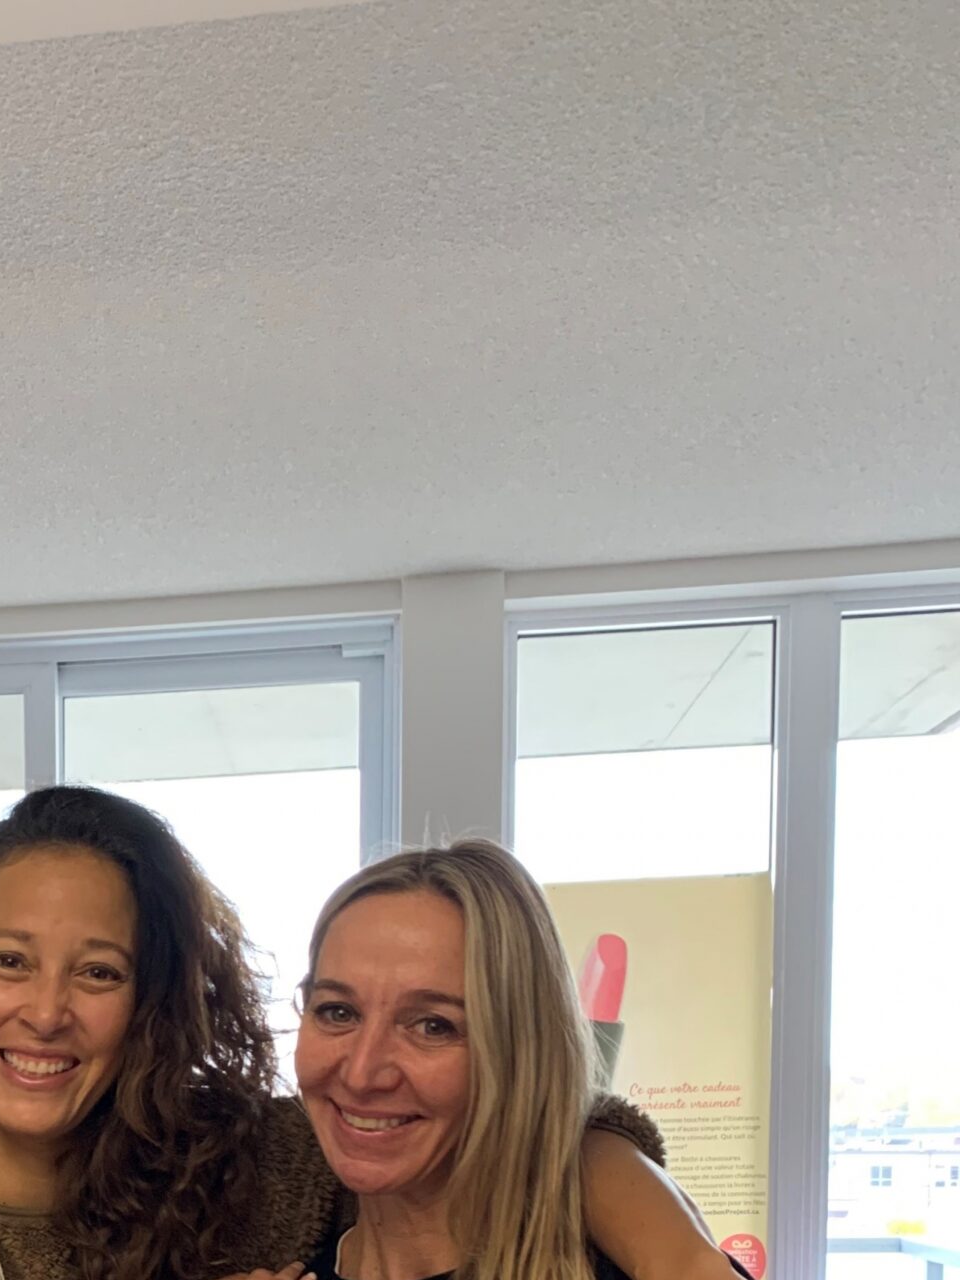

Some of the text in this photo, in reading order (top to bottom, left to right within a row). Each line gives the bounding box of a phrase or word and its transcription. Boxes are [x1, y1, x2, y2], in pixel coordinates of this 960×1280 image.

[629, 1081, 741, 1099] Ce que votre cadeau
[690, 1097, 742, 1109] vraiment
